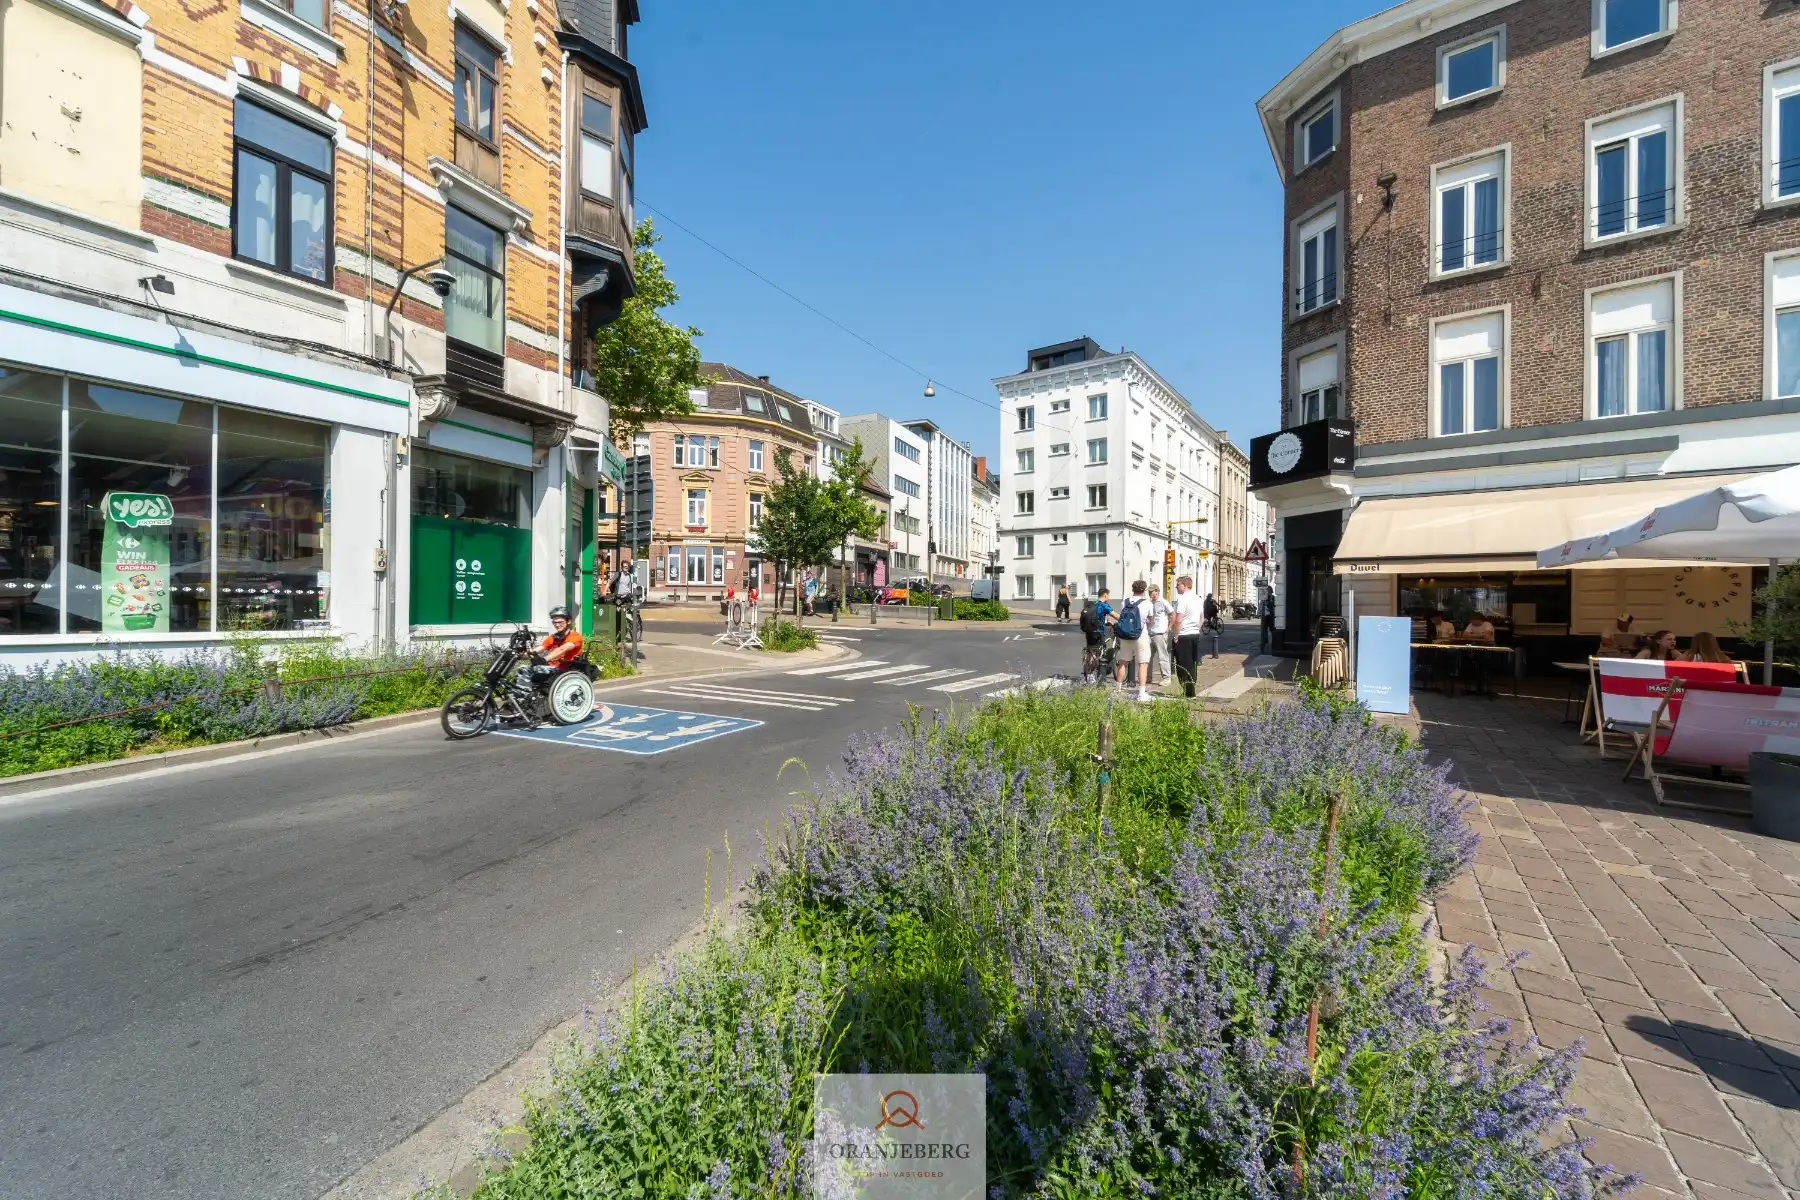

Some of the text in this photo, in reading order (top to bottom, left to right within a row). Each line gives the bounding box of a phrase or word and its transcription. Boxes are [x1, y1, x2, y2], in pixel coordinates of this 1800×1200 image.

[1280, 448, 1299, 457] Corner
[113, 497, 168, 518] yes!
[117, 551, 146, 560] WIN
[1350, 563, 1380, 572] Duvel
